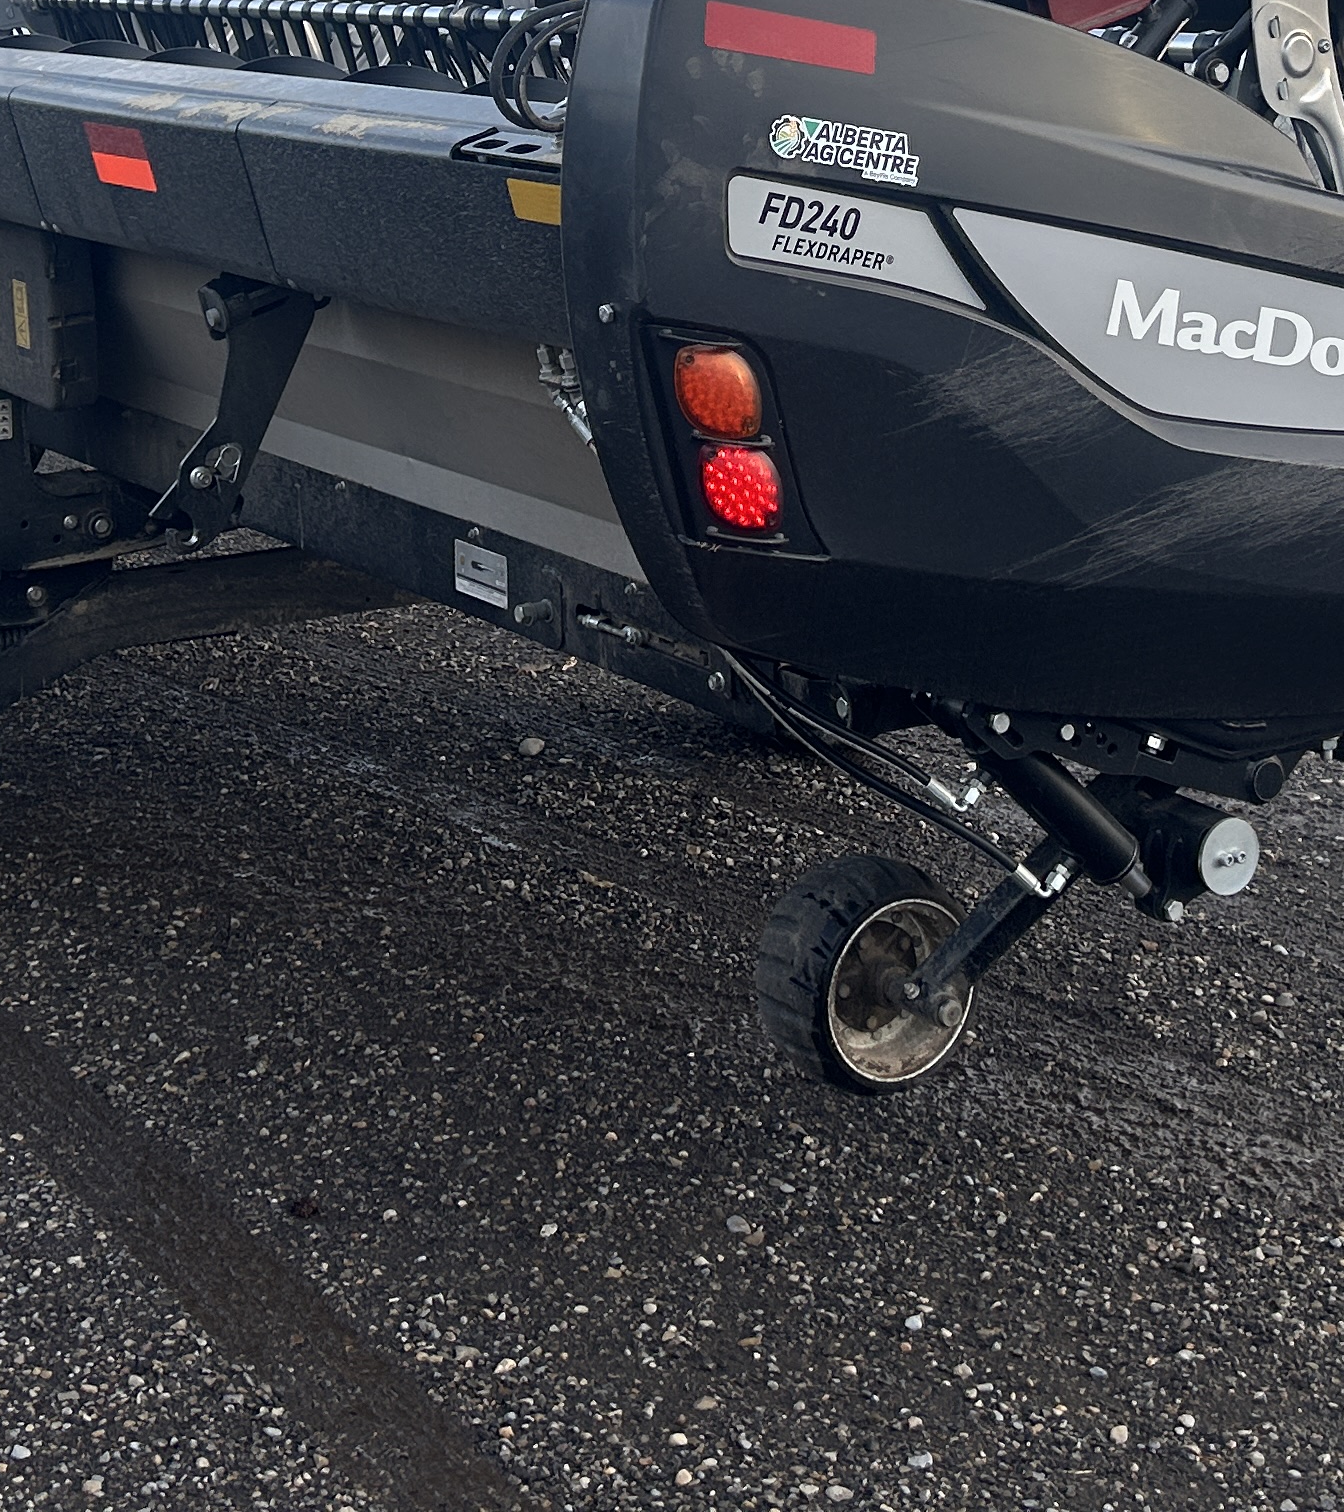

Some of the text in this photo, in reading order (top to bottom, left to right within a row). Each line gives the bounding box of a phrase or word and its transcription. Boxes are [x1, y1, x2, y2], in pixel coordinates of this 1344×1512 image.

[816, 123, 907, 155] ALBERTA
[805, 142, 917, 175] AG CENTRE
[758, 192, 861, 240] FD240
